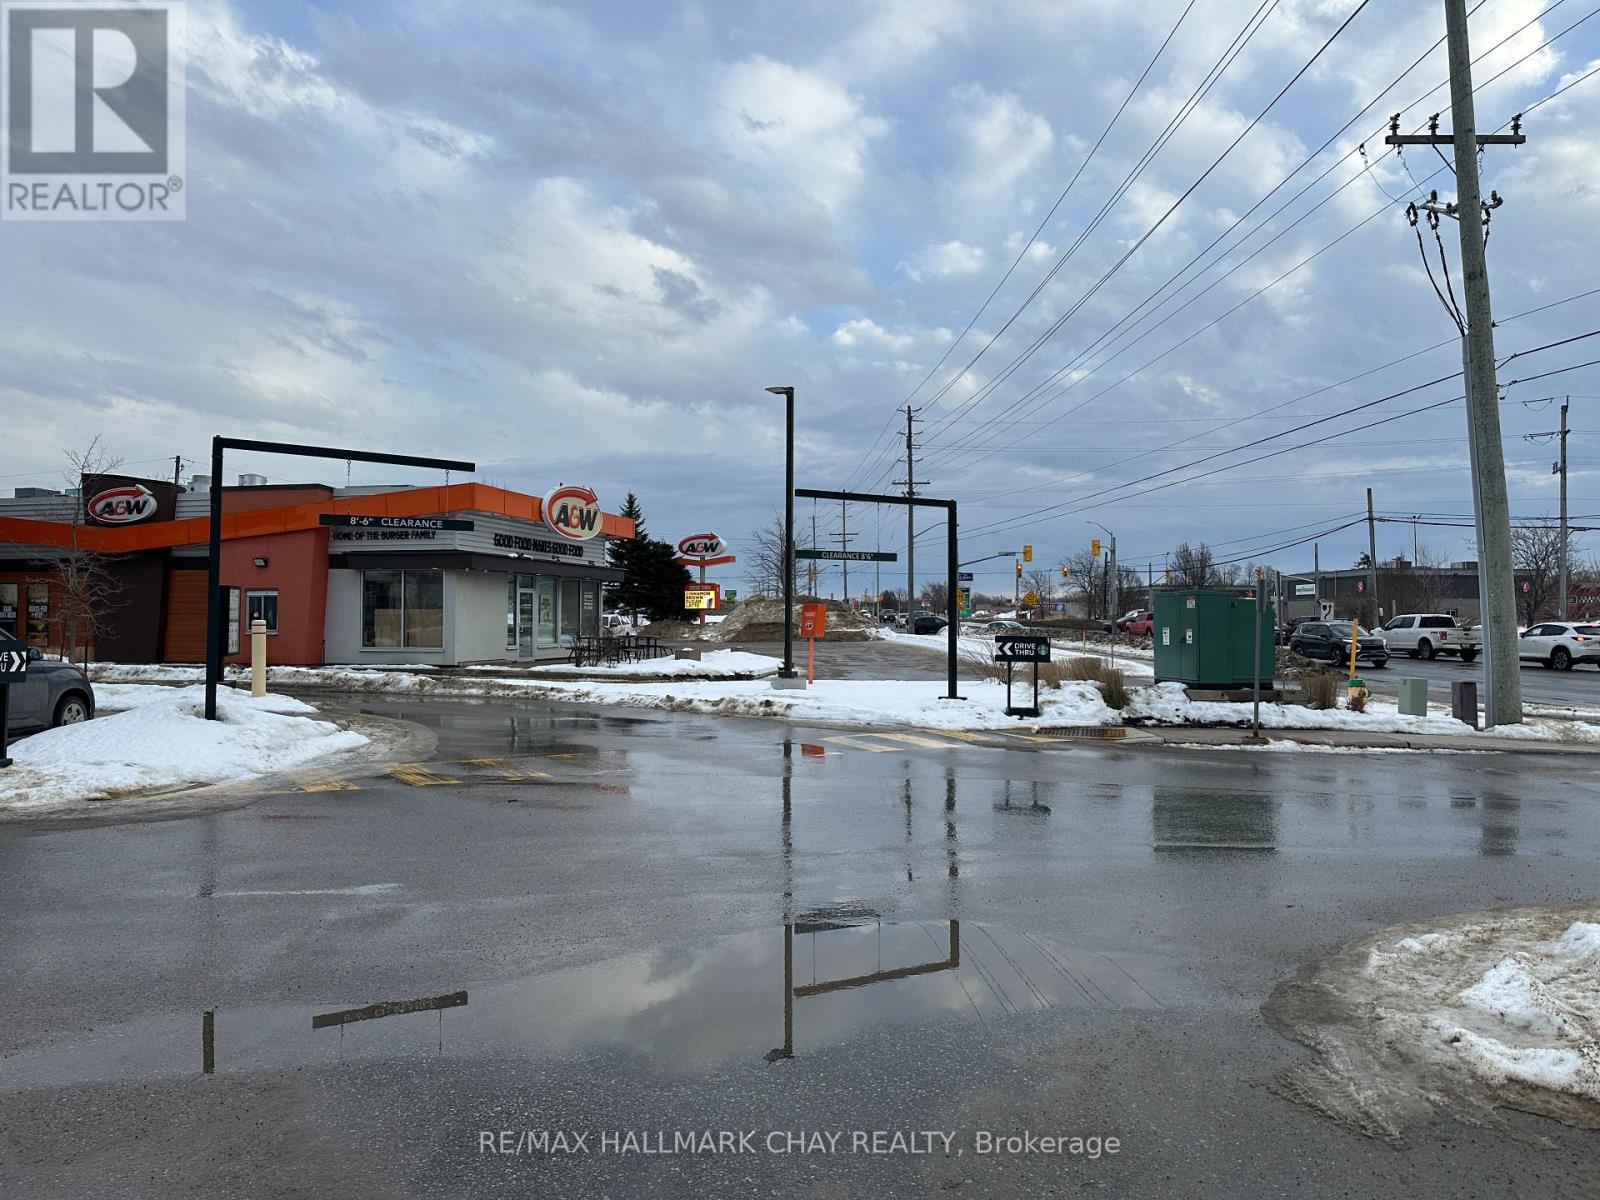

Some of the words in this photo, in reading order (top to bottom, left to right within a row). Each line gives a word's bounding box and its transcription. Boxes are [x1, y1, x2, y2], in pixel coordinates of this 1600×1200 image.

[99, 498, 150, 516] A&W
[555, 502, 599, 531] A&W
[381, 518, 443, 528] CLEARANCE
[333, 531, 354, 541] HOME
[354, 531, 365, 541] OF
[366, 531, 380, 540] THE
[381, 531, 410, 540] BURGER
[411, 530, 436, 540] FAMILY
[494, 533, 513, 548] GOOD
[514, 536, 532, 551] FOOD
[552, 541, 569, 555] GOOD
[569, 544, 584, 557] FOOD
[686, 542, 720, 553] A&W
[822, 551, 860, 560] CLEARANCE
